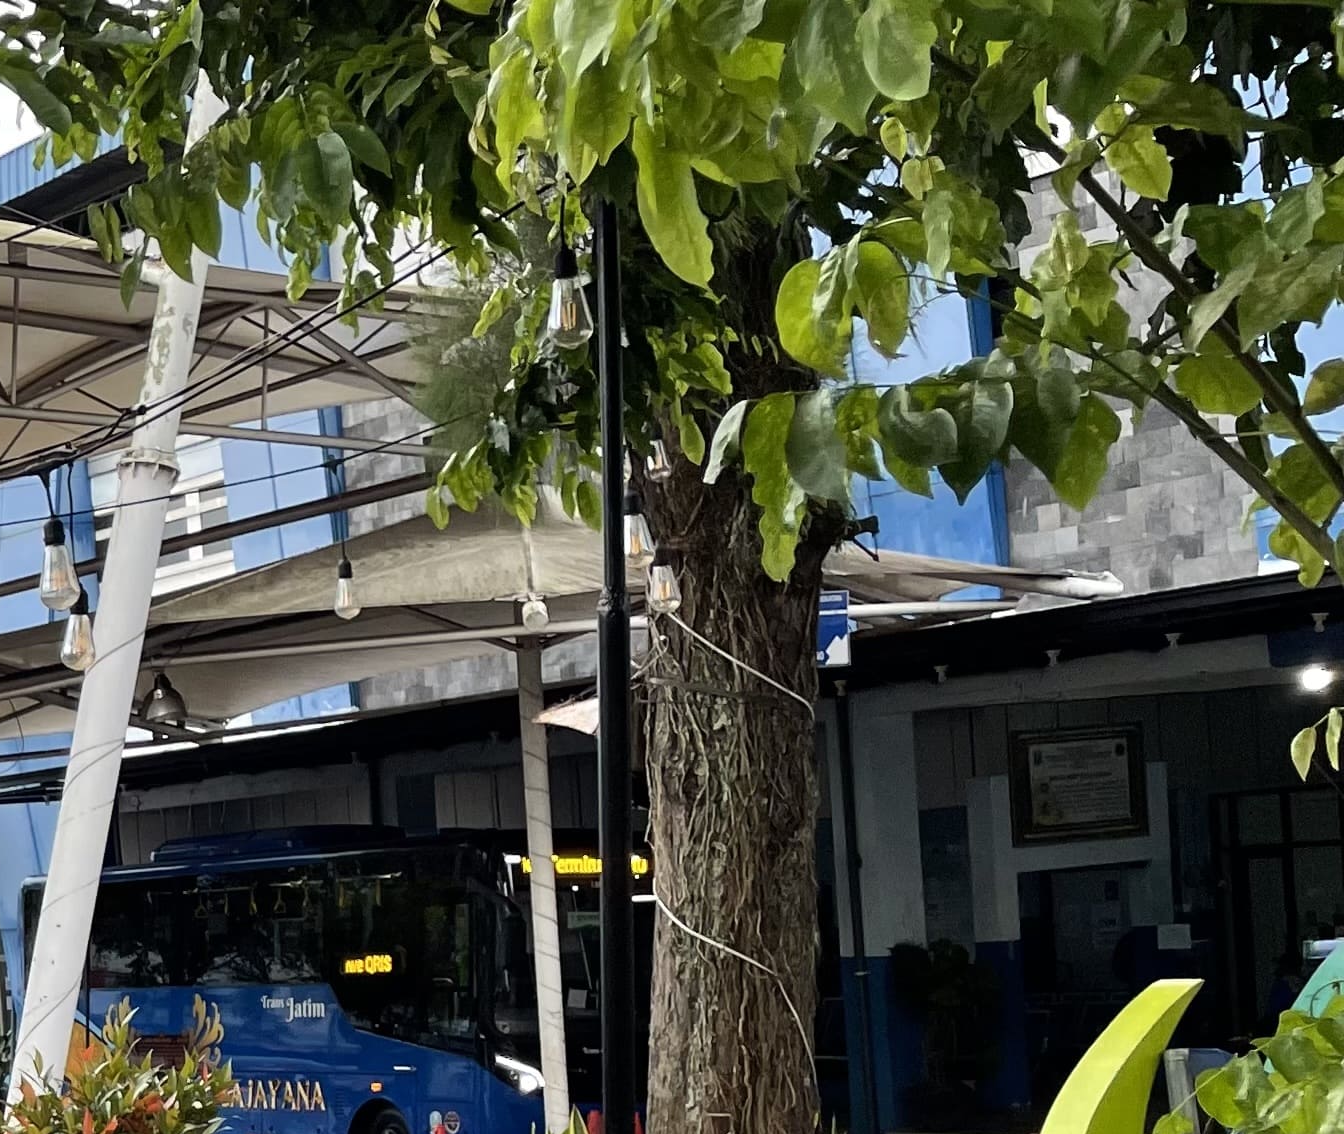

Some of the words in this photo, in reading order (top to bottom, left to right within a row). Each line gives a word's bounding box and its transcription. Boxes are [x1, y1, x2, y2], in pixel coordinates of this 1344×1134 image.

[364, 954, 393, 974] QRIS
[260, 995, 285, 1008] Trans
[285, 997, 325, 1022] Jatim
